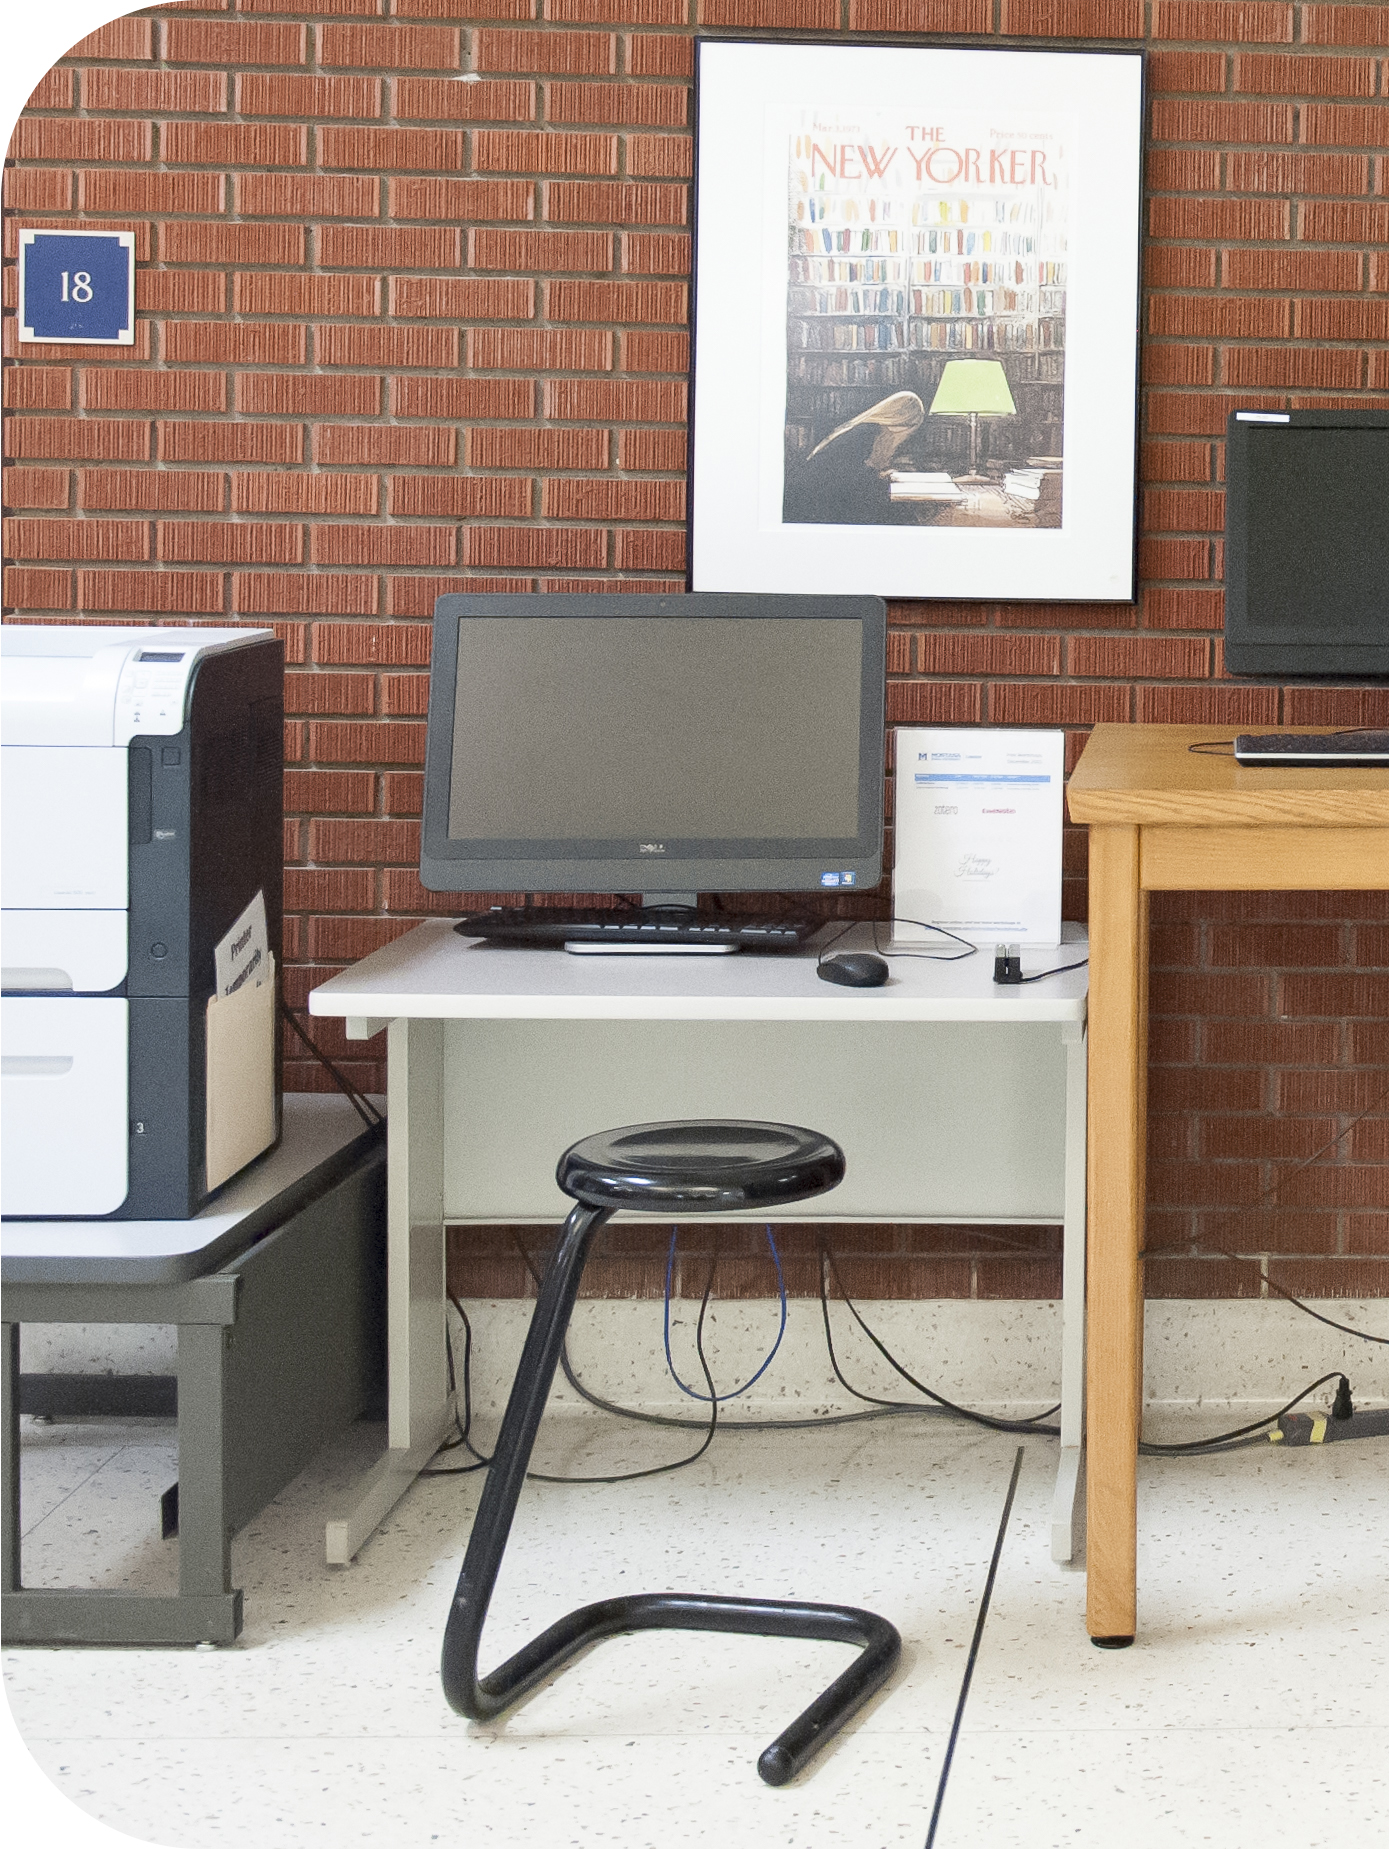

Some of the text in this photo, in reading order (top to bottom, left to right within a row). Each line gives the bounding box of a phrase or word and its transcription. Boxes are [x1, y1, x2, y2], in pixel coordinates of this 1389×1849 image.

[905, 125, 946, 143] THE
[989, 127, 1015, 139] Price
[1029, 132, 1054, 140] cents
[811, 143, 1052, 186] NEW YORKER
[61, 271, 94, 303] 18
[230, 924, 253, 961] Printer
[136, 1121, 145, 1134] 3
